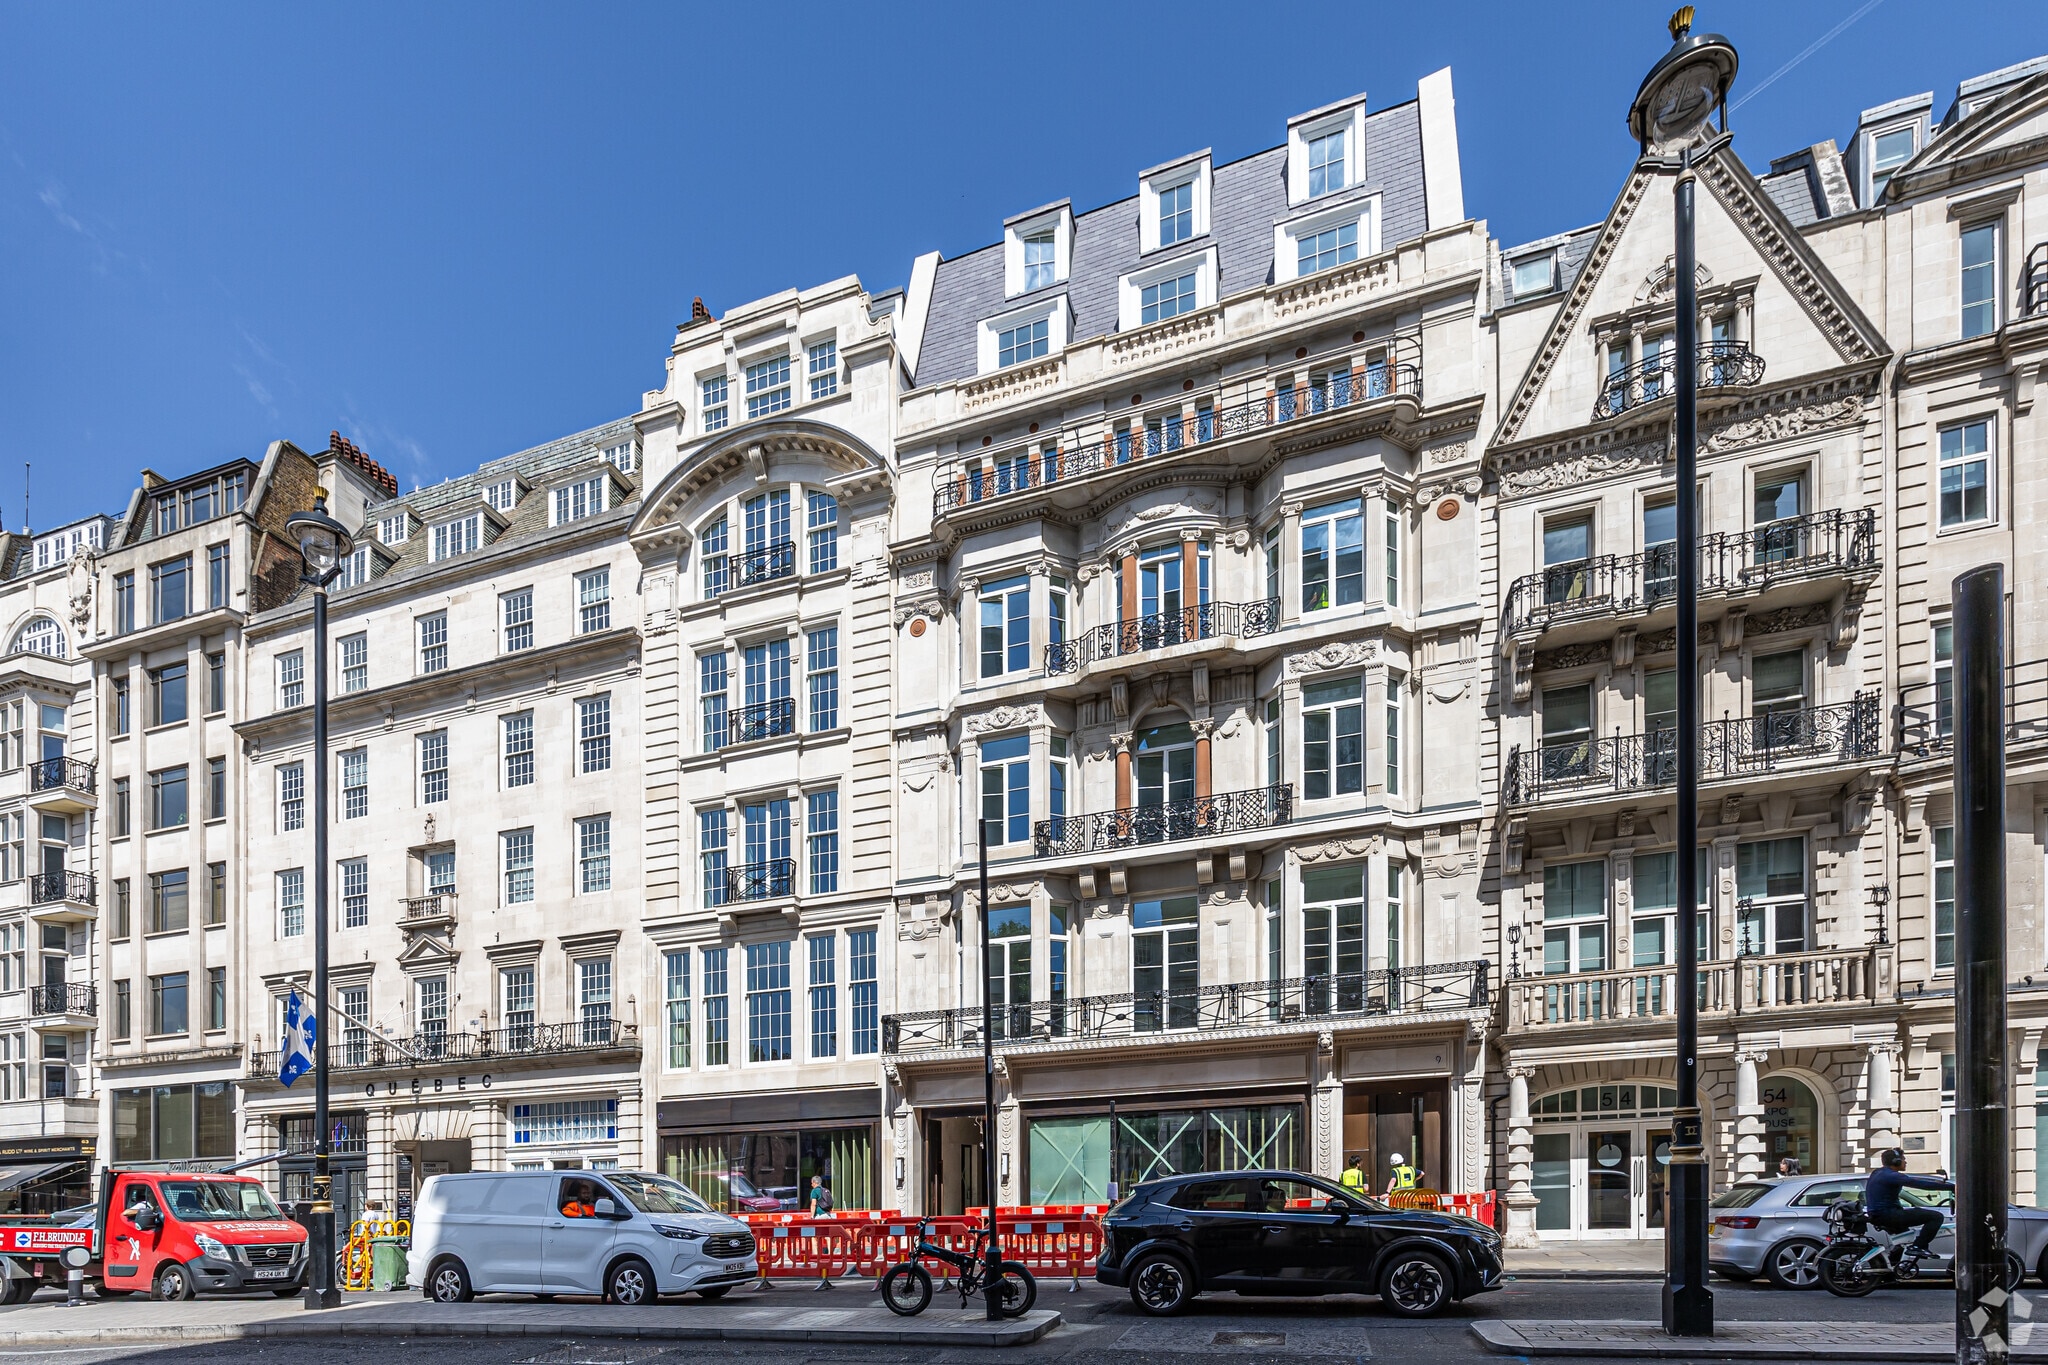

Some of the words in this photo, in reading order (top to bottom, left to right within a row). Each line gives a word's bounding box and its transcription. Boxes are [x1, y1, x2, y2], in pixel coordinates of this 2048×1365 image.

[1686, 1057, 1694, 1066] 9
[365, 1074, 492, 1097] QUÉBEC
[1763, 1087, 1787, 1104] 54
[1765, 1118, 1795, 1128] OUSE
